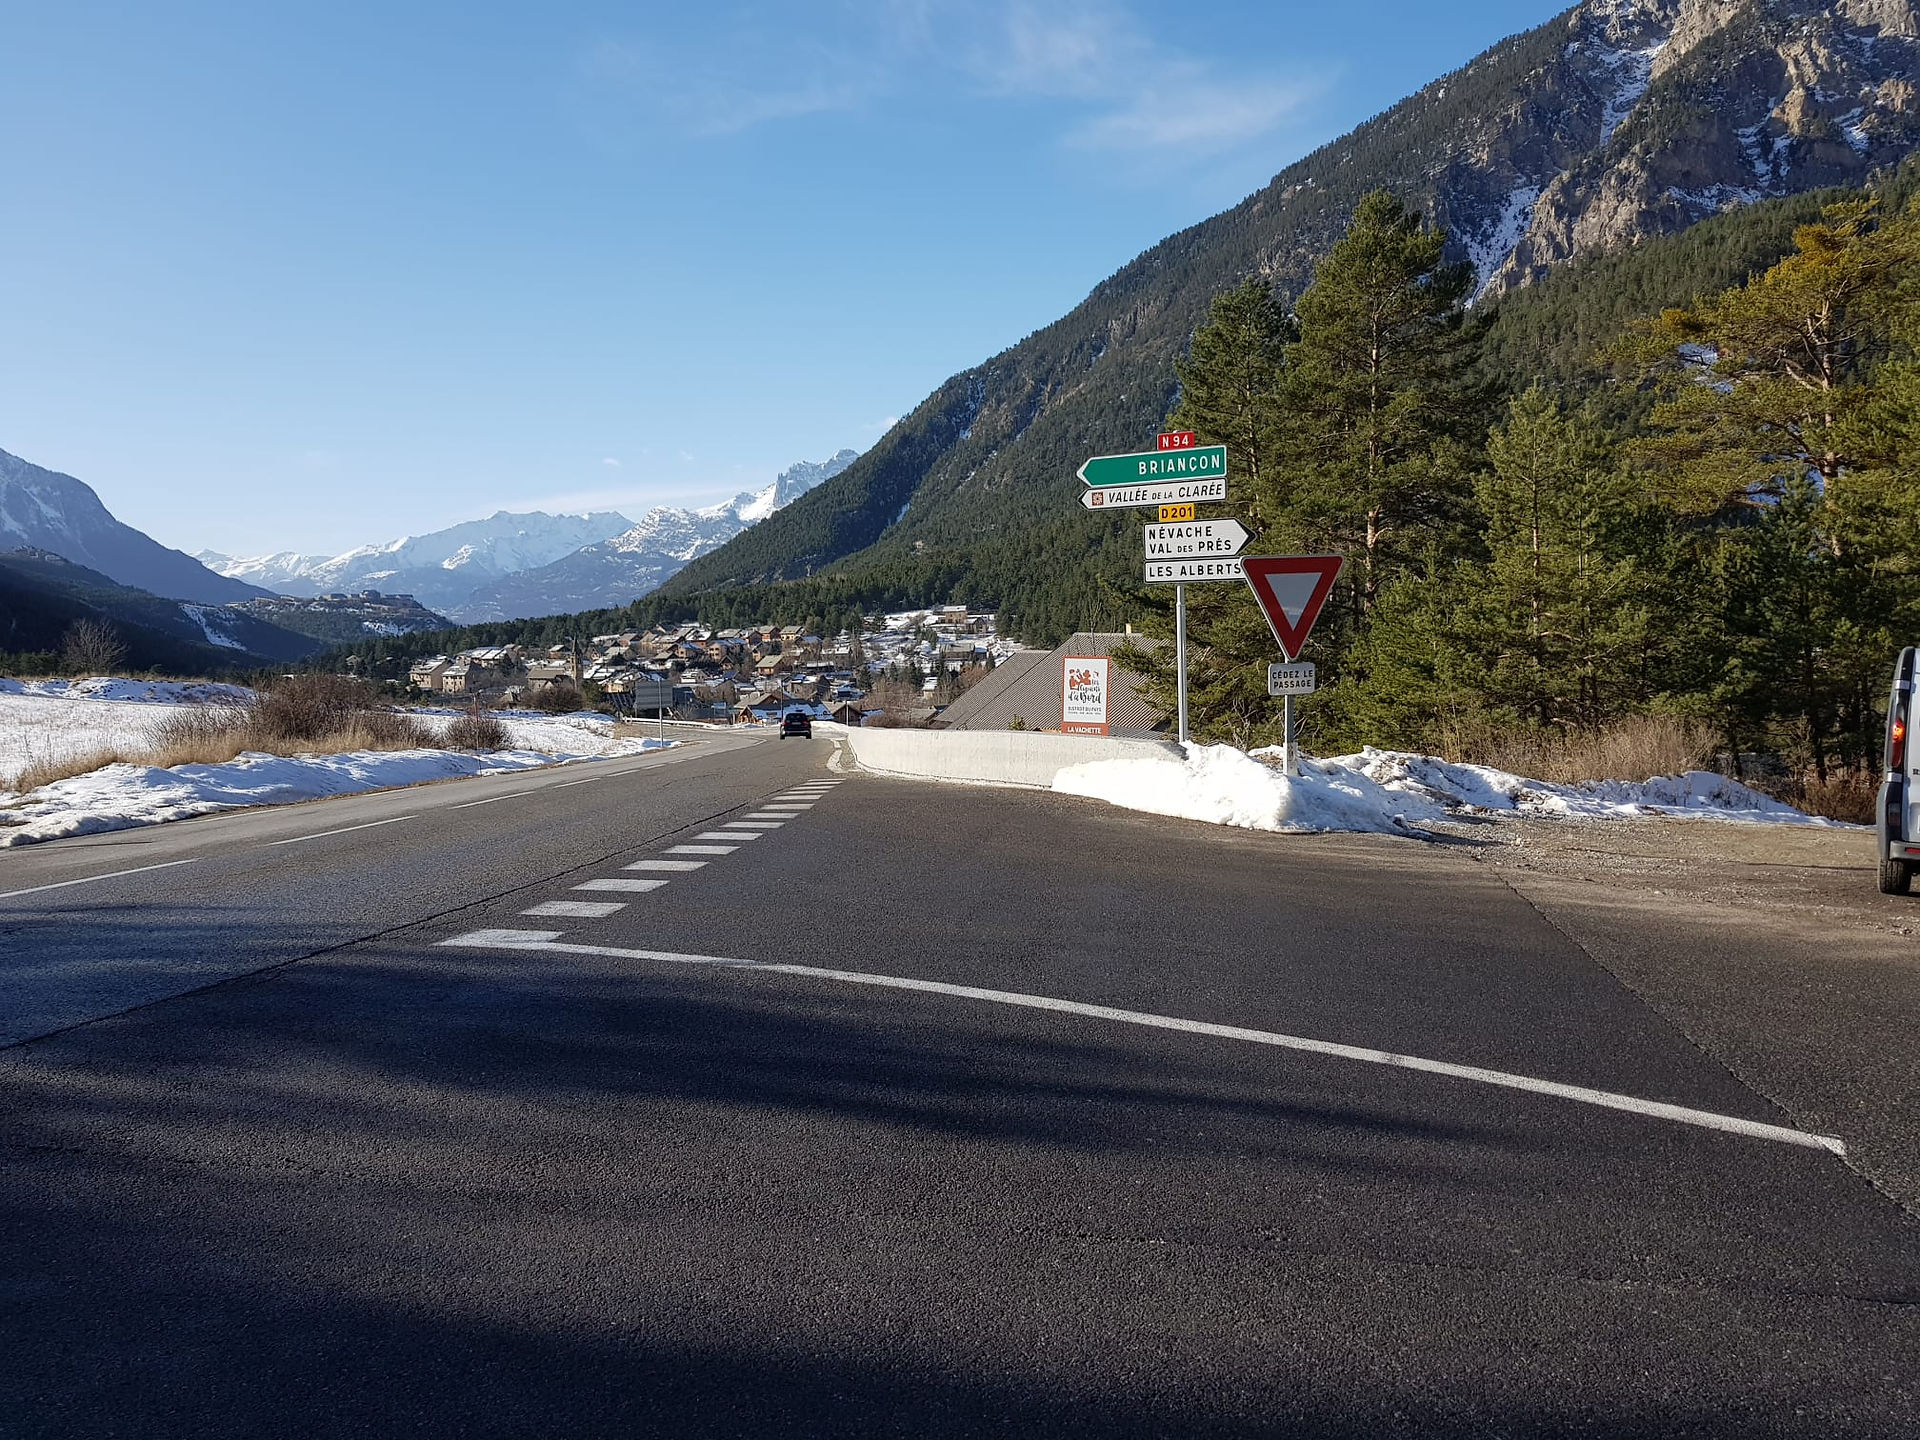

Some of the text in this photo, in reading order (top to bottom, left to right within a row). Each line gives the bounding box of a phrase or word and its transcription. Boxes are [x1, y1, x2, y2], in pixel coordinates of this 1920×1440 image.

[1162, 434, 1189, 448] N 94
[1138, 454, 1220, 475] BRIANÇON
[1108, 482, 1222, 503] VALLÉE DE LA CLARÉE
[1148, 525, 1213, 540] NÉVACHE
[1150, 539, 1232, 554] VAL DES PRÉS
[1149, 563, 1241, 578] LES ALBERTS
[1272, 669, 1313, 679] CÉDEZ LE
[1273, 679, 1312, 689] PASSAGE
